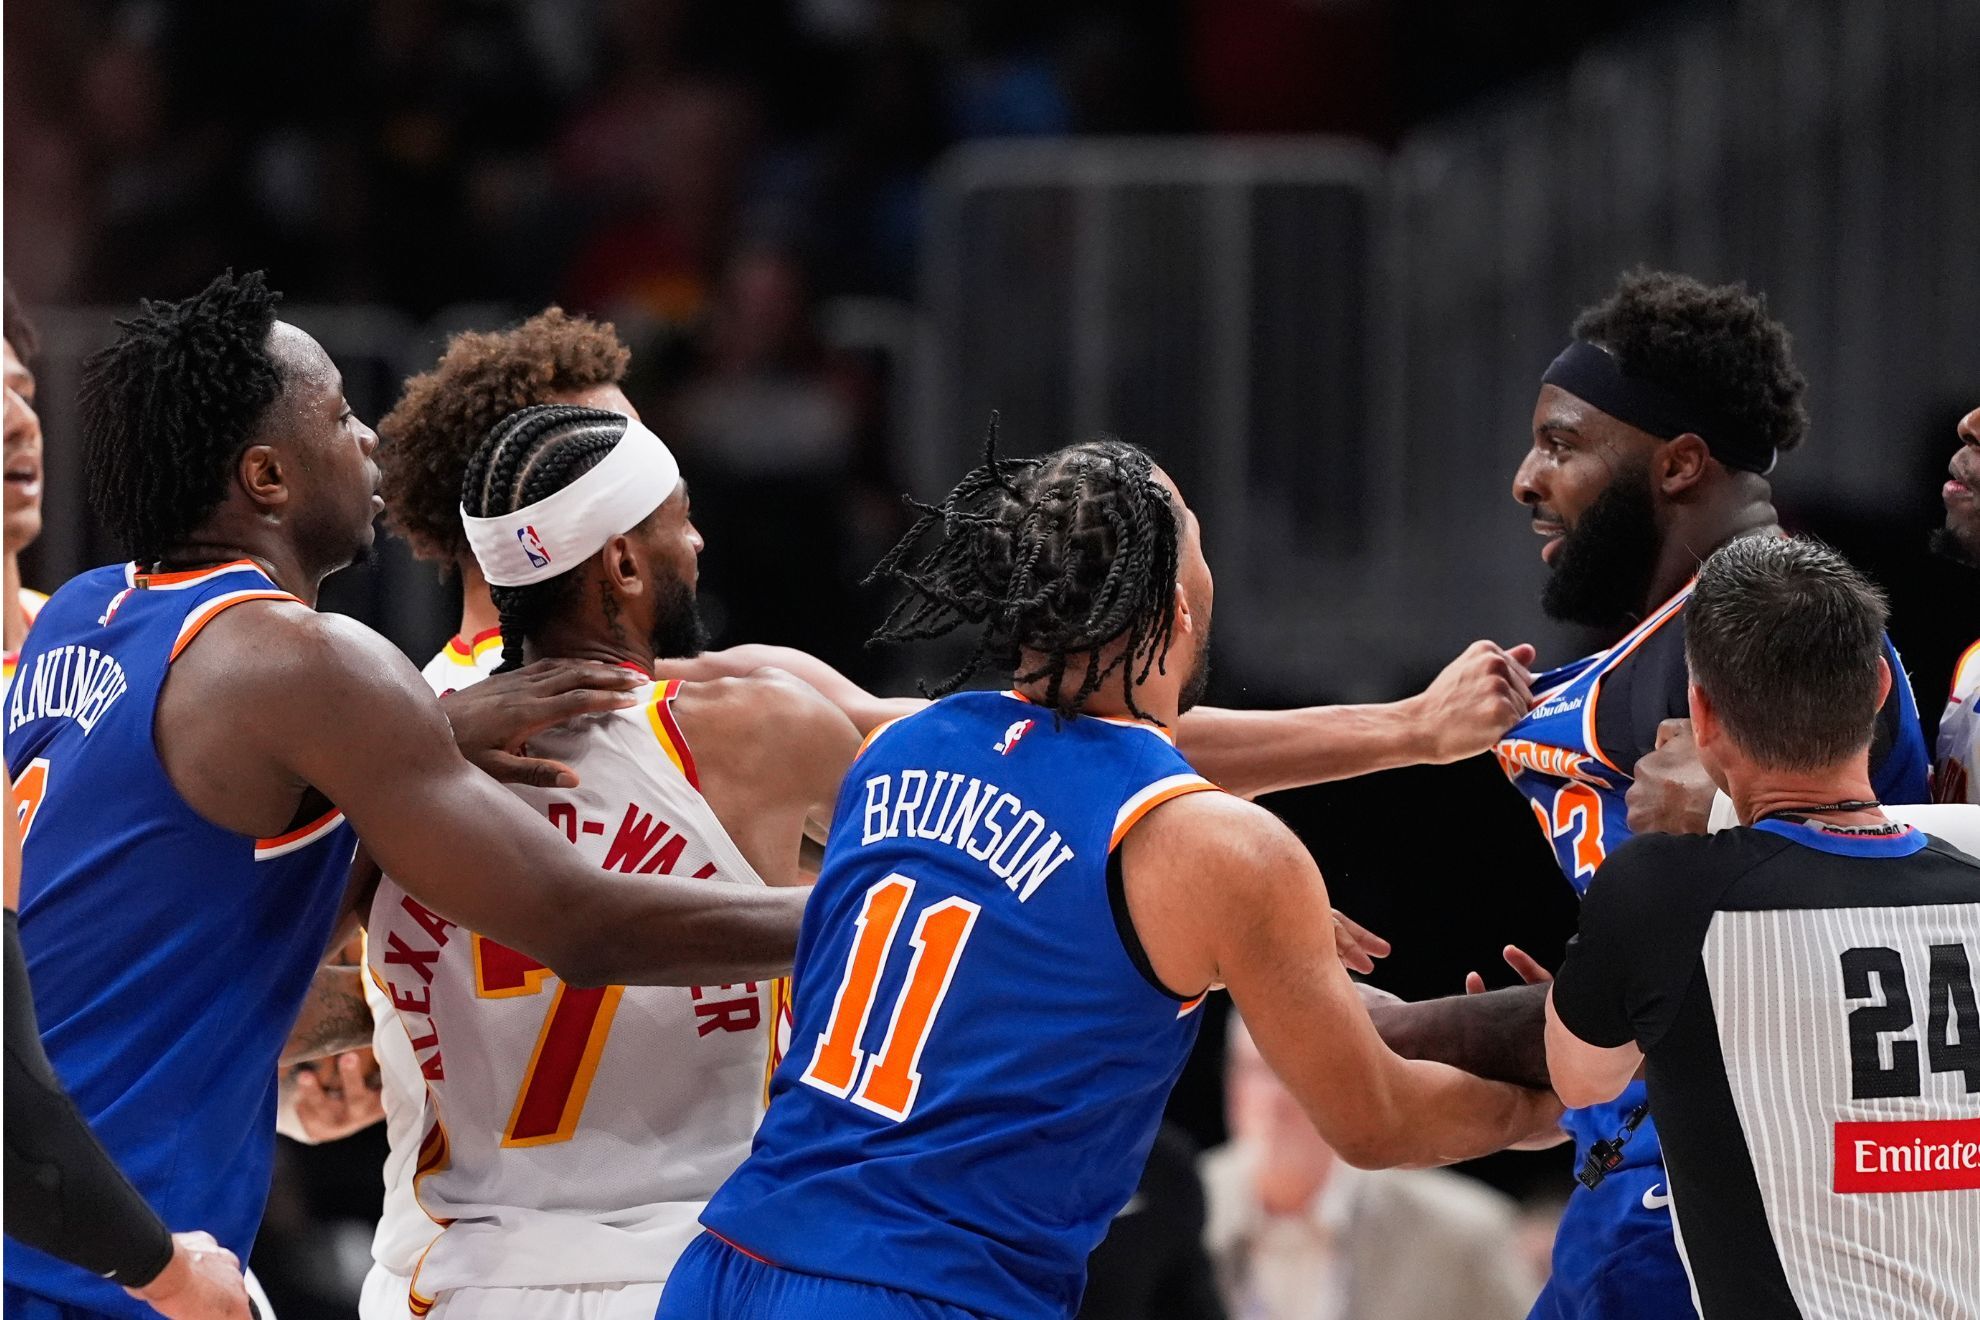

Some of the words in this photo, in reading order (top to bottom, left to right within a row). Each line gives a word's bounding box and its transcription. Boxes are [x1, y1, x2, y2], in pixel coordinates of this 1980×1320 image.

[8, 645, 128, 737] ANUNOBY
[861, 769, 1075, 903] BRUNSON
[470, 931, 625, 1149] 7
[799, 872, 982, 1123] 11
[1839, 943, 1980, 1100] 24
[1854, 1137, 1980, 1173] Emirate
